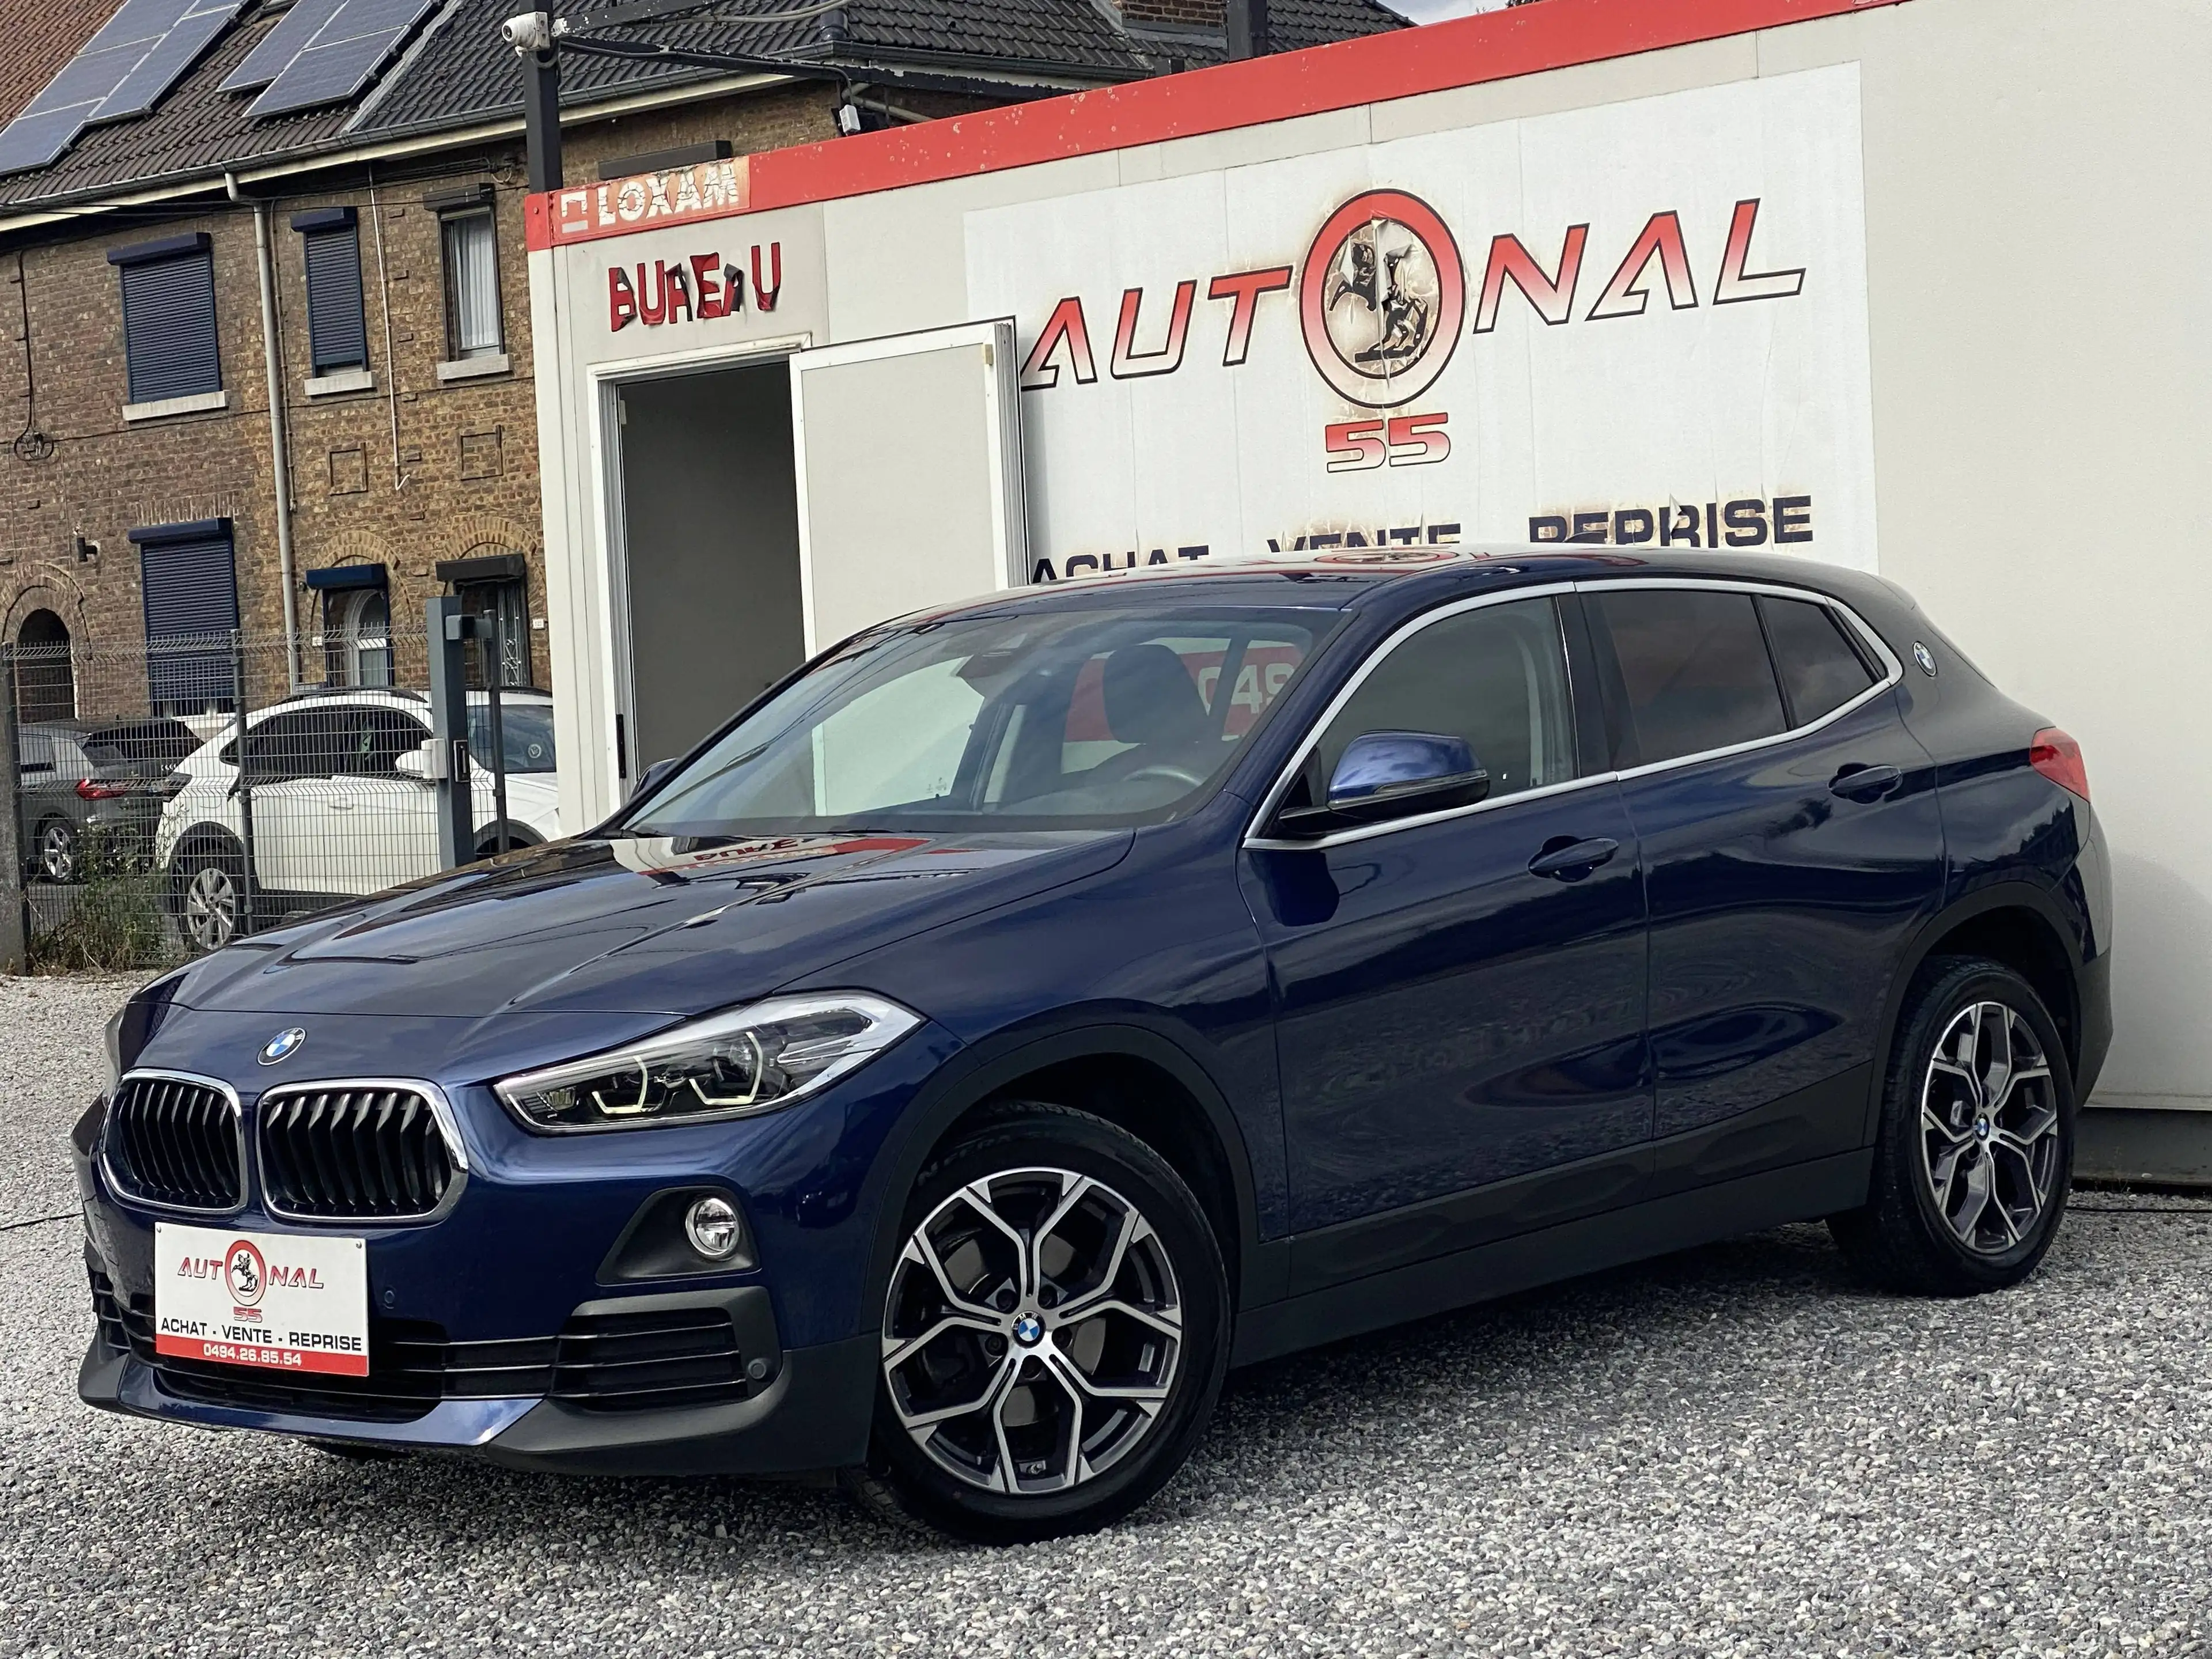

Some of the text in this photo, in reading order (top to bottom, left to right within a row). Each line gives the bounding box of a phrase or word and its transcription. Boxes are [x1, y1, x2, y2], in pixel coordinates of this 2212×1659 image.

[597, 163, 740, 226] LOXAM
[1324, 412, 1450, 473] 55
[177, 1239, 324, 1306] AUTONAL
[161, 1317, 362, 1351] ACHAT VENTE REPRISE
[233, 1306, 263, 1323] 55
[203, 1342, 302, 1366] 0494.26.85.54
